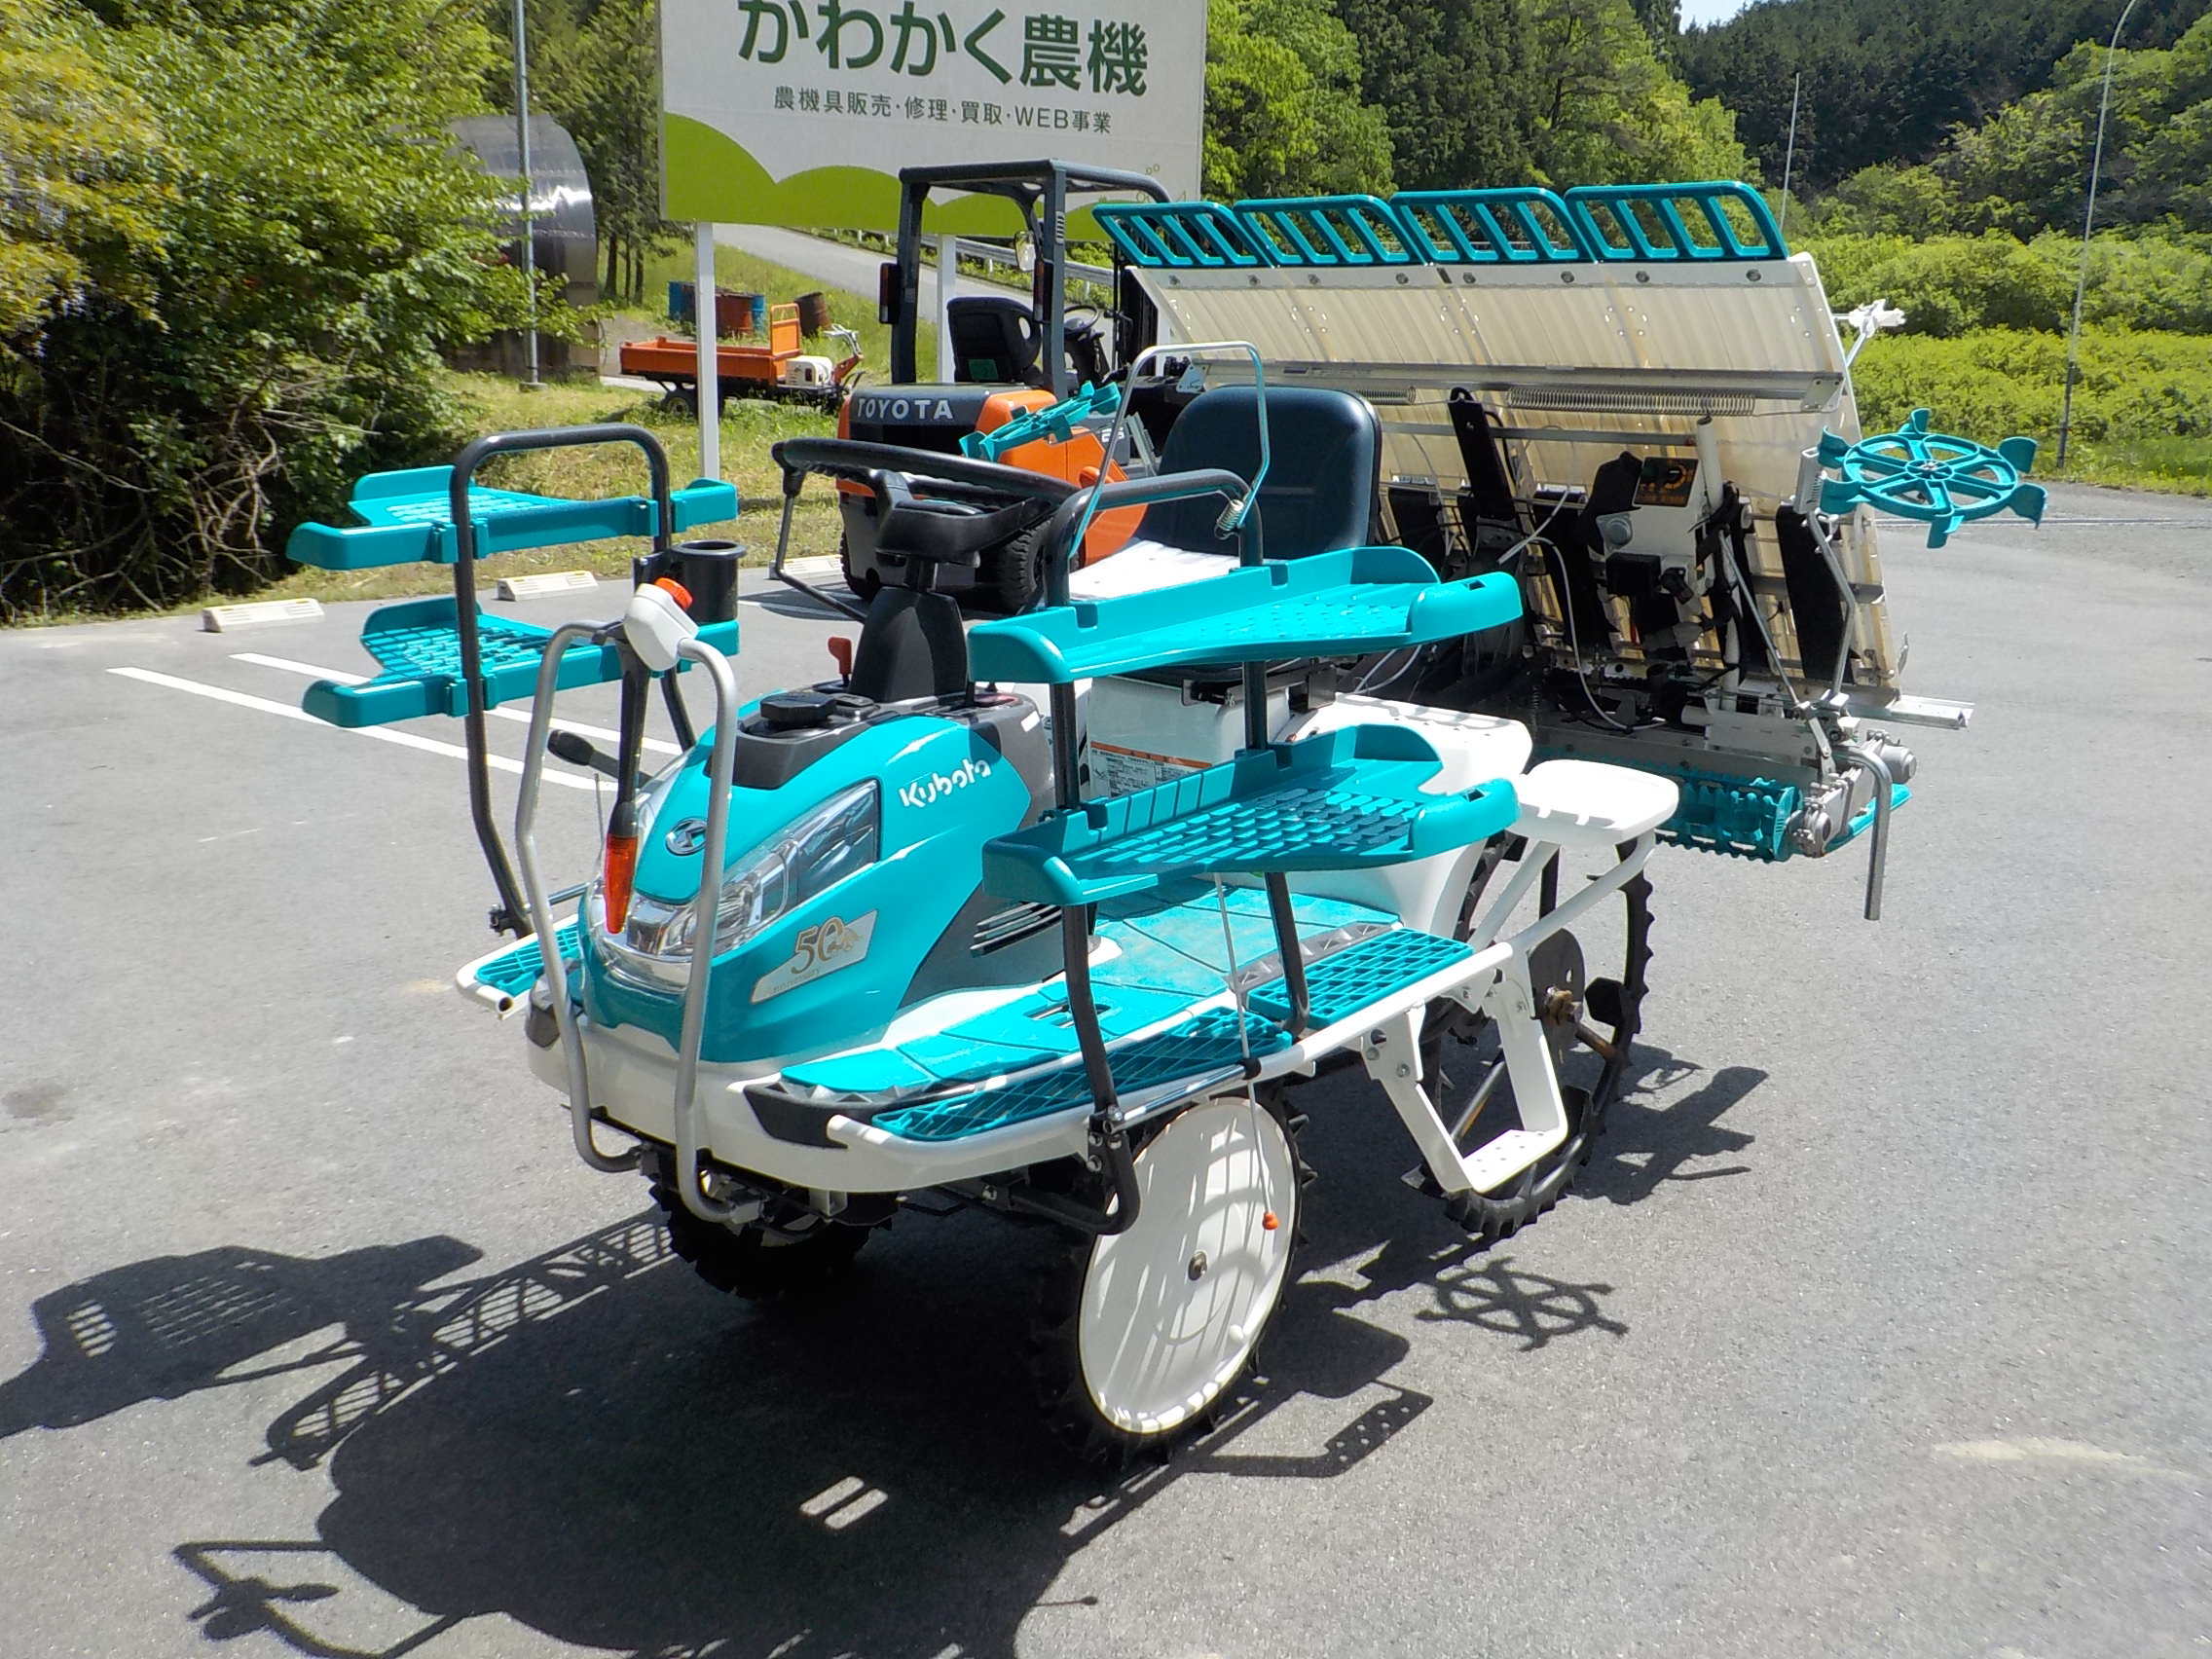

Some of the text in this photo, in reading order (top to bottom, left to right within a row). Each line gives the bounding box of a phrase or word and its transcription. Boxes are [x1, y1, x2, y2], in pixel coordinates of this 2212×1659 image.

[737, 0, 1149, 95] かわかく農機
[856, 397, 954, 421] TOYOTA
[899, 758, 992, 808] Kubota
[791, 917, 845, 975] 50
